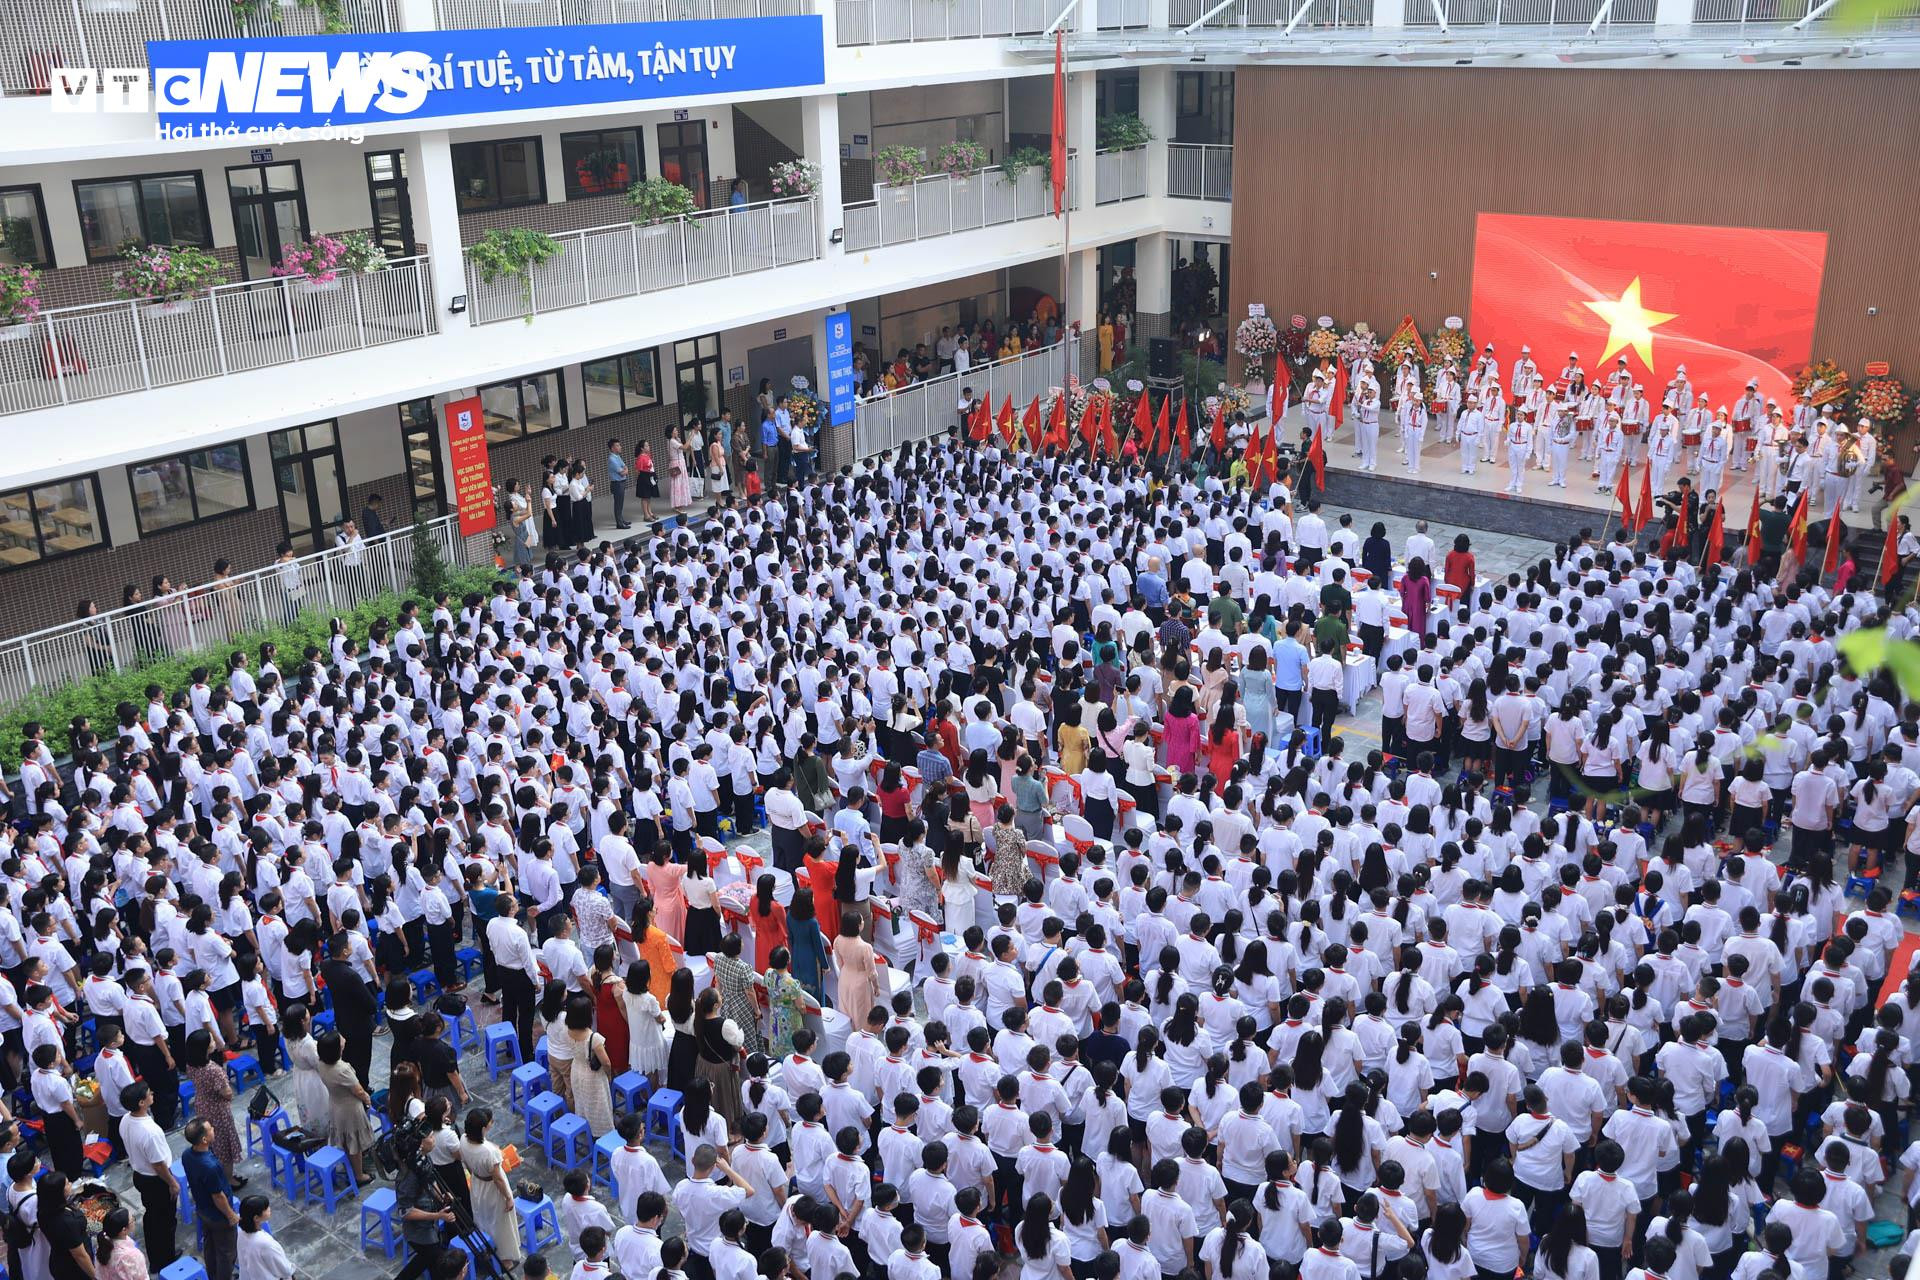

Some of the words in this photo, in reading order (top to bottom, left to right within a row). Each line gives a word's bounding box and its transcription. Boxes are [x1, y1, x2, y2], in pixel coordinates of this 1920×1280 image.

[458, 50, 523, 94] TUỆ,
[526, 46, 565, 84] TỪ
[568, 45, 635, 84] TÂM,
[637, 41, 687, 82] TẬN
[689, 45, 737, 79] TỤY
